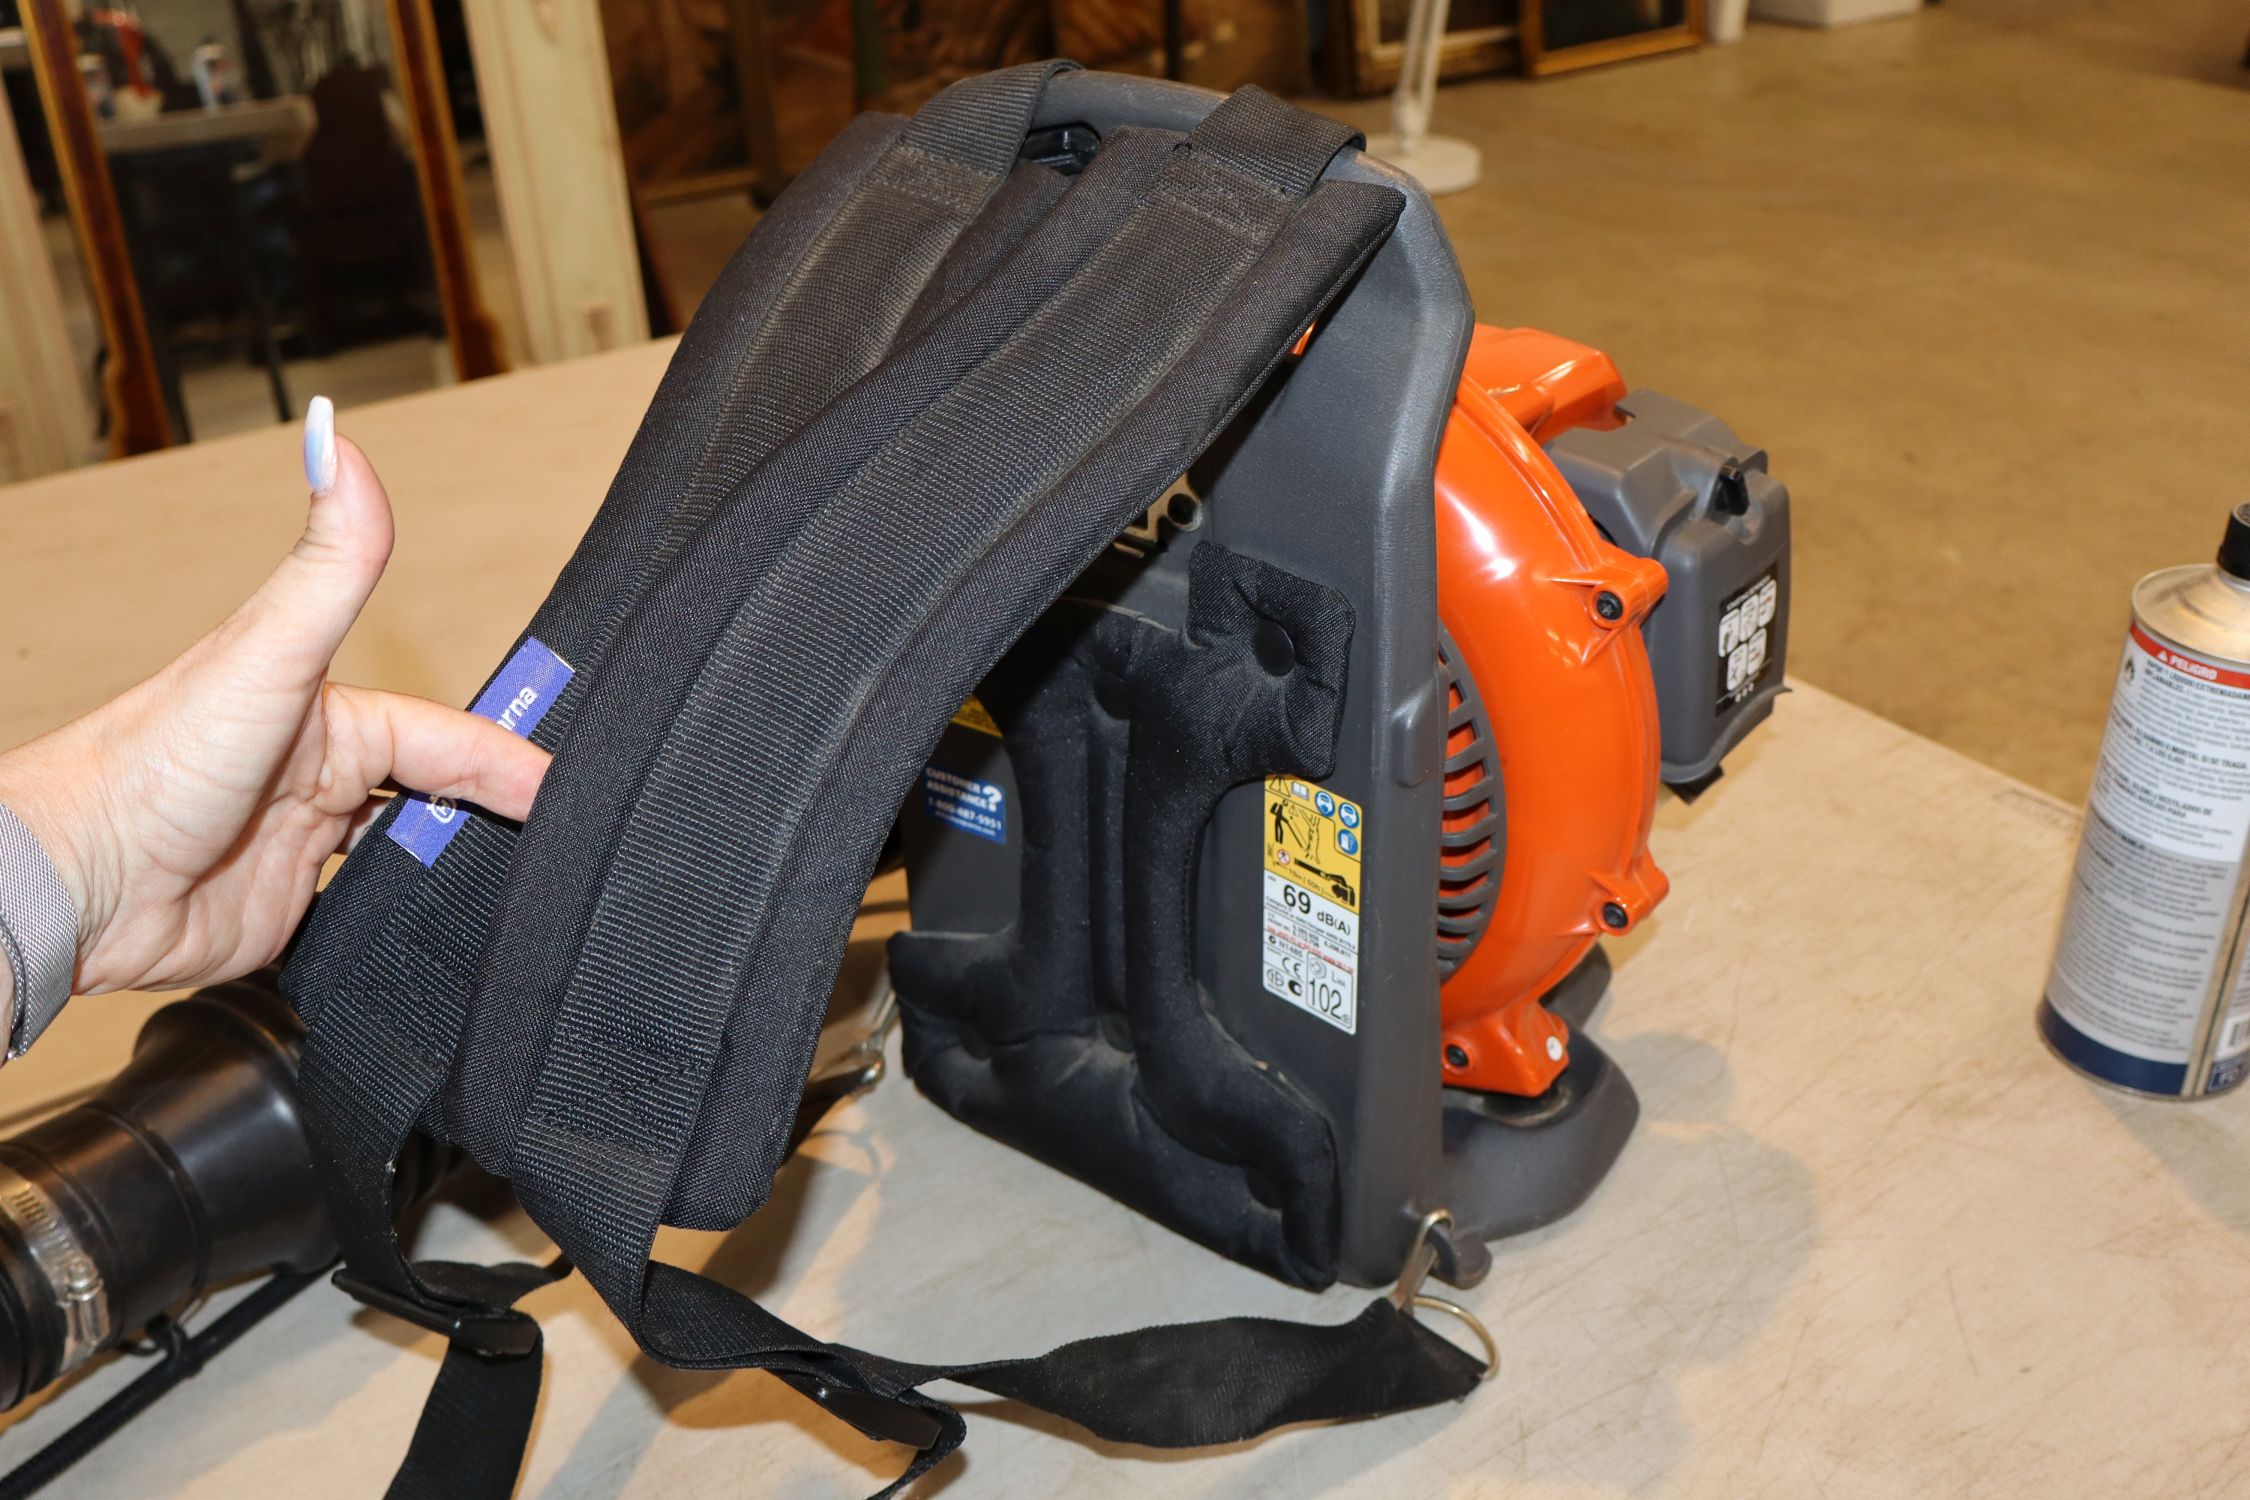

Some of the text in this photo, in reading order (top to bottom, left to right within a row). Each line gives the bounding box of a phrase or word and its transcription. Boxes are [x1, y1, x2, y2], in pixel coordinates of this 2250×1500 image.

[2169, 655, 2217, 681] PELIGRO
[927, 766, 981, 795] CUSTOMER
[1283, 884, 1311, 915] 69
[1316, 911, 1351, 936] dB(A)
[1309, 979, 1342, 1020] 102
